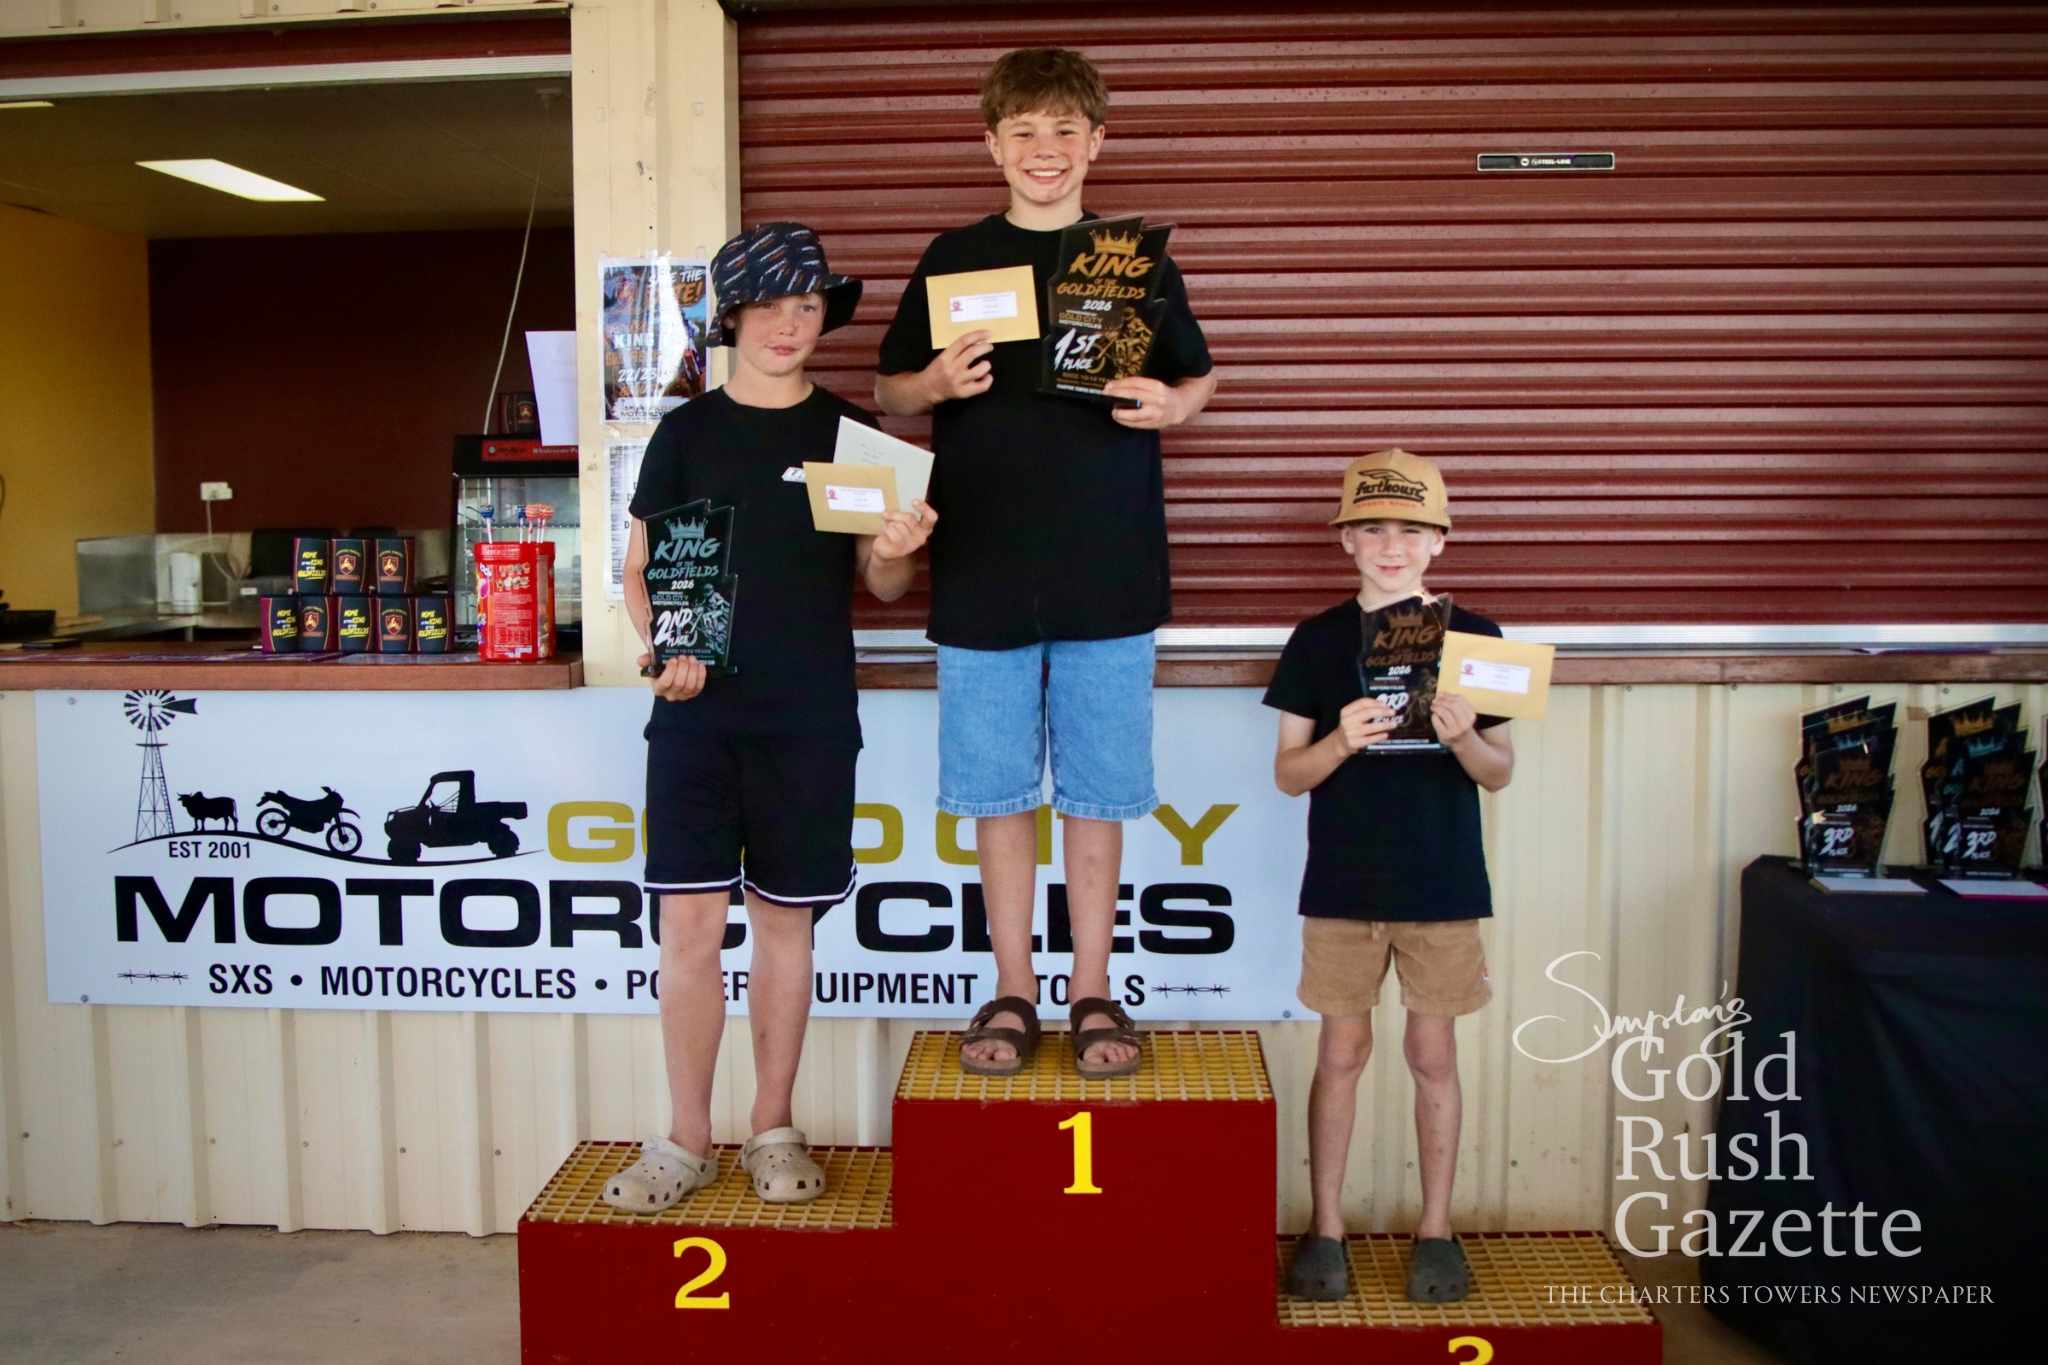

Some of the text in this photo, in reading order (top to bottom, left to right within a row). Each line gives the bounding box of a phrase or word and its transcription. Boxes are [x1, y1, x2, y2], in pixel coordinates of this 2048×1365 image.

[1068, 253, 1156, 278] KING
[680, 270, 703, 283] THE
[1057, 282, 1146, 299] GOLDFIELDS
[1082, 300, 1113, 312] 2026
[1058, 319, 1102, 329] MOTORCYCLES
[1059, 312, 1104, 324] GOLD CITY
[613, 333, 655, 349] KING
[1054, 328, 1102, 371] 1ST
[1063, 358, 1094, 371] PLACE
[653, 537, 721, 563] KING
[647, 565, 719, 581] GOLDFIELDS
[671, 579, 695, 590] 2026
[343, 609, 359, 617] HOME
[421, 610, 436, 618] HOME
[653, 606, 693, 647] 2ND
[666, 635, 690, 648] PLACE
[1373, 626, 1439, 649] KING
[1366, 652, 1436, 667] GOLDFIELDS
[1388, 665, 1412, 675] 2026
[1825, 770, 1883, 788] KING
[1836, 803, 1858, 812] 2026
[1979, 807, 2001, 816] 2026
[547, 801, 904, 865] GD
[1818, 827, 1855, 856] 3RD
[1962, 831, 1997, 859] 3RD
[168, 841, 252, 859] EST 2001
[114, 875, 1236, 955] MOTORCLES
[209, 964, 274, 996] SXS
[321, 966, 577, 999] MOTORCYCLES
[815, 971, 978, 1005] UIPMENT
[1058, 1111, 1103, 1196] 1
[672, 1237, 731, 1311] 2
